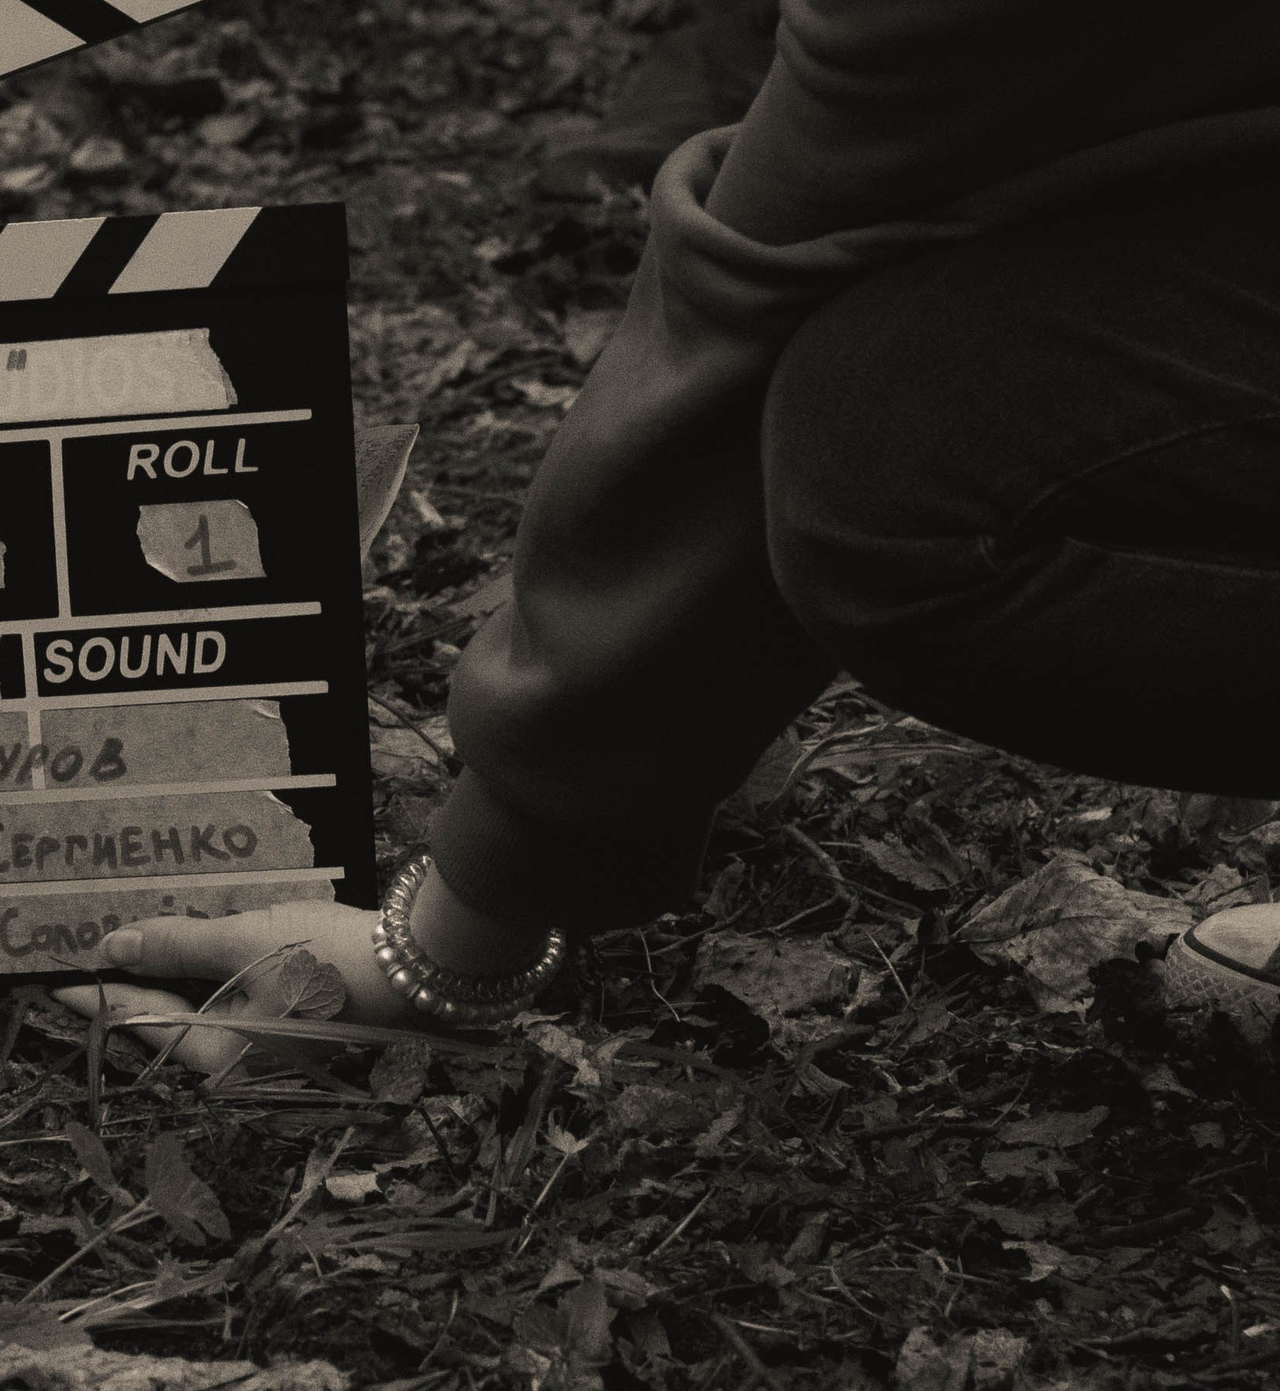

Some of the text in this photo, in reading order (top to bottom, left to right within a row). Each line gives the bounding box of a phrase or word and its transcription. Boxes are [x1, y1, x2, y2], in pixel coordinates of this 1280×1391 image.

[127, 438, 260, 482] ROLL
[182, 514, 238, 574] 1
[42, 630, 228, 685] SOUND
